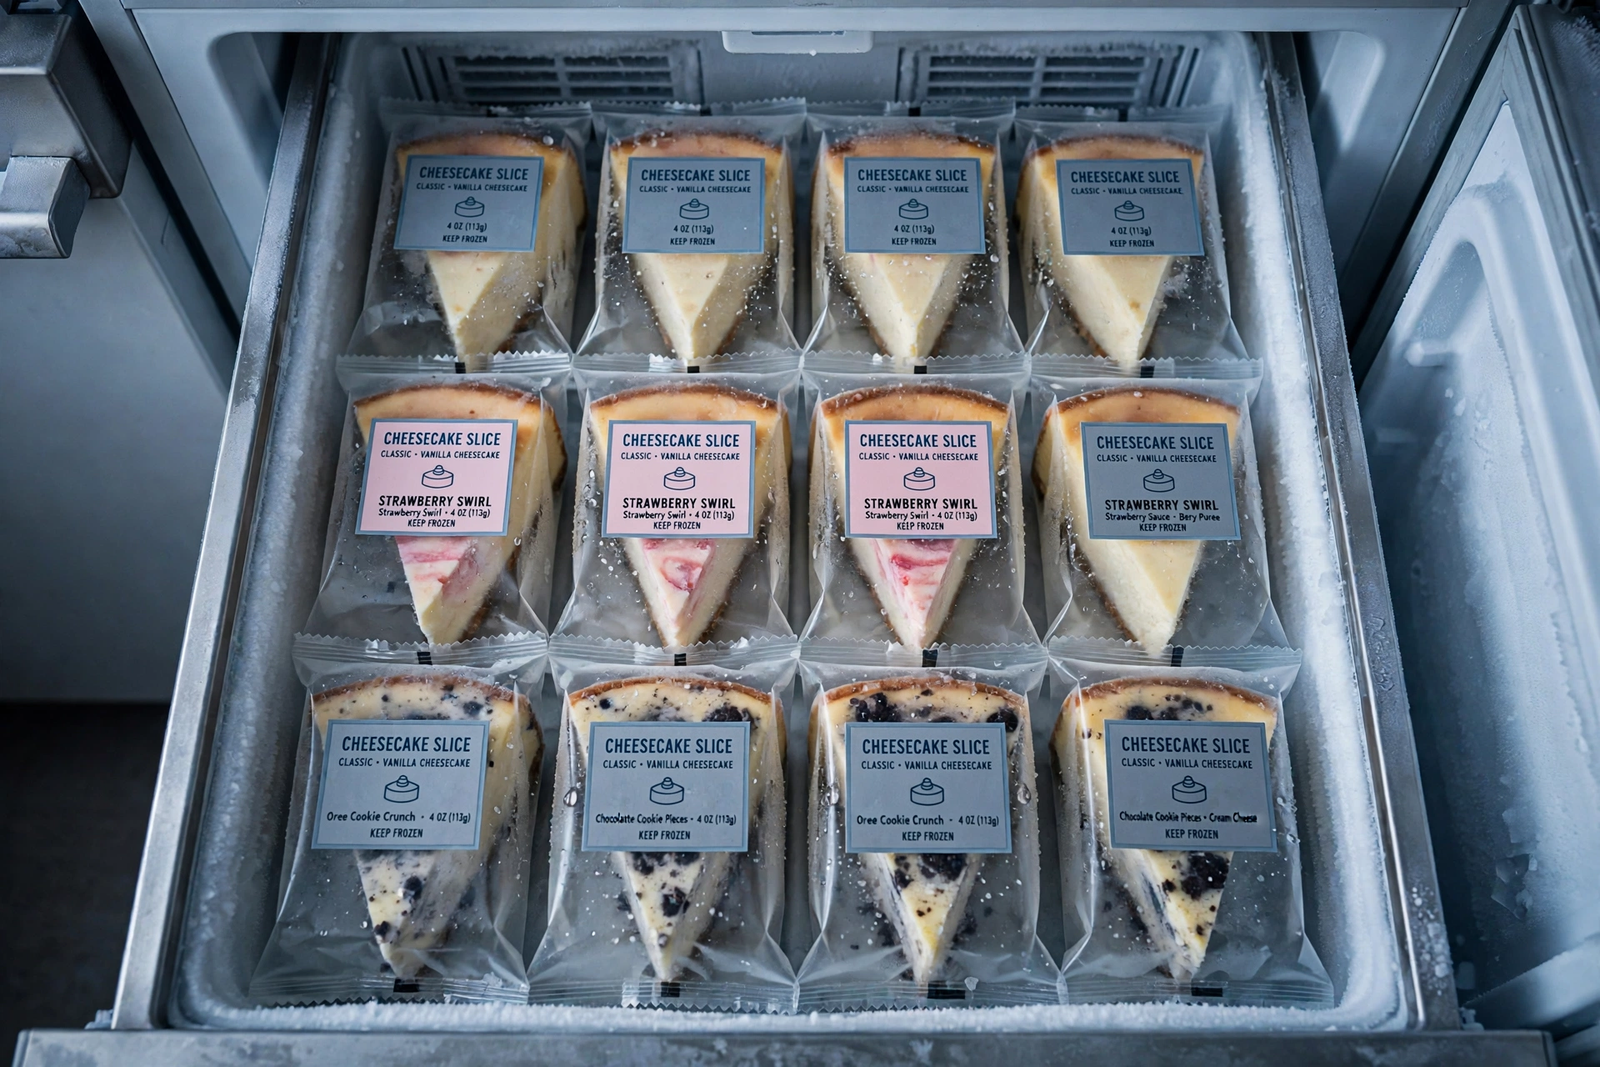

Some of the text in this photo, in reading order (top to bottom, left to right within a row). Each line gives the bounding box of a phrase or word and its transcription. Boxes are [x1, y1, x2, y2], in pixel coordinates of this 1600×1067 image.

[419, 166, 529, 180] CHEESECAKE SLICE
[641, 169, 751, 181] CHEESECAKE SLICE
[858, 169, 967, 181] CHEESECAKE SLICE
[1071, 171, 1180, 183] CHEESECAKE SLICE
[454, 183, 482, 191] VANILLA
[484, 184, 528, 192] CHEESECAKE
[454, 222, 462, 230] OZ
[465, 223, 487, 232] (113g)
[680, 225, 689, 233] OZ
[692, 225, 714, 235] (113g)
[901, 225, 910, 233] OZ
[912, 225, 935, 235] (113g)
[1129, 227, 1152, 236] (113g)
[384, 432, 501, 446] CHEESECAKE SLICE
[623, 434, 740, 447] CHEESECAKE SLICE
[860, 434, 977, 448] CHEESECAKE SLICE
[1097, 436, 1214, 450] CHEESECAKE SLICE
[381, 450, 411, 458] CLASSIC
[454, 451, 500, 459] CHEESECAKE
[621, 452, 651, 460] CLASSIC
[1097, 454, 1127, 462] CLASSIC
[379, 495, 492, 507] STRAWBERRY SWIRL
[623, 498, 735, 508] STRAWBERRY SWIRL
[864, 498, 978, 509] STRAWBERRY SWIRL
[1105, 500, 1219, 511] STRAWBERRY SWIRL
[378, 508, 421, 518] Strawberry
[422, 508, 442, 516] Swirl
[468, 509, 490, 519] (113g)
[623, 510, 665, 520] Strawberry
[667, 511, 686, 519] Swirl
[702, 511, 711, 519] OZ
[713, 511, 734, 521] (113g)
[865, 511, 908, 521] Strawberry
[910, 511, 928, 519] Swirl
[937, 511, 942, 519] 4
[955, 511, 978, 521] (113g)
[1105, 512, 1146, 522] Strawberry
[1148, 513, 1170, 521] Sauce
[408, 519, 456, 527] KEEP FROZEN
[917, 522, 944, 530] FROZEN
[1139, 524, 1186, 532] KEEP FROZEN
[342, 736, 471, 752] CHEESECAKE SLICE
[606, 738, 732, 753] CHEESECAKE SLICE
[862, 739, 990, 754] CHEESECAKE SLICE
[1122, 737, 1250, 753] CHEESECAKE SLICE
[338, 758, 470, 767] CLASSIC VANILLA CHEESECAKE
[603, 760, 733, 769] CLASSIC VANILLA CHEESECAKE
[861, 761, 992, 770] CLASSIC VANILLA CHEESECAKE
[1122, 758, 1253, 769] CLASSIC VANILLA CHEESECAKE
[350, 811, 381, 822] Cookie
[383, 811, 415, 822] Crunch
[429, 813, 434, 821] 4
[437, 813, 447, 822] OZ
[448, 813, 471, 824] (113g)
[637, 814, 663, 824] Cookie
[697, 814, 702, 823] 4
[704, 814, 713, 823] OZ
[716, 814, 736, 826] (113g)
[880, 815, 910, 825] Cookie
[912, 815, 944, 825] Crunch
[958, 816, 963, 825] 4
[966, 816, 975, 825] OZ
[977, 816, 999, 827] (113g)
[370, 828, 423, 838] KEEP FROZEN
[638, 831, 691, 840] KEEP FROZEN
[902, 832, 954, 841] KEEP FROZEN
[1165, 829, 1219, 839] KEEP FROZEN
